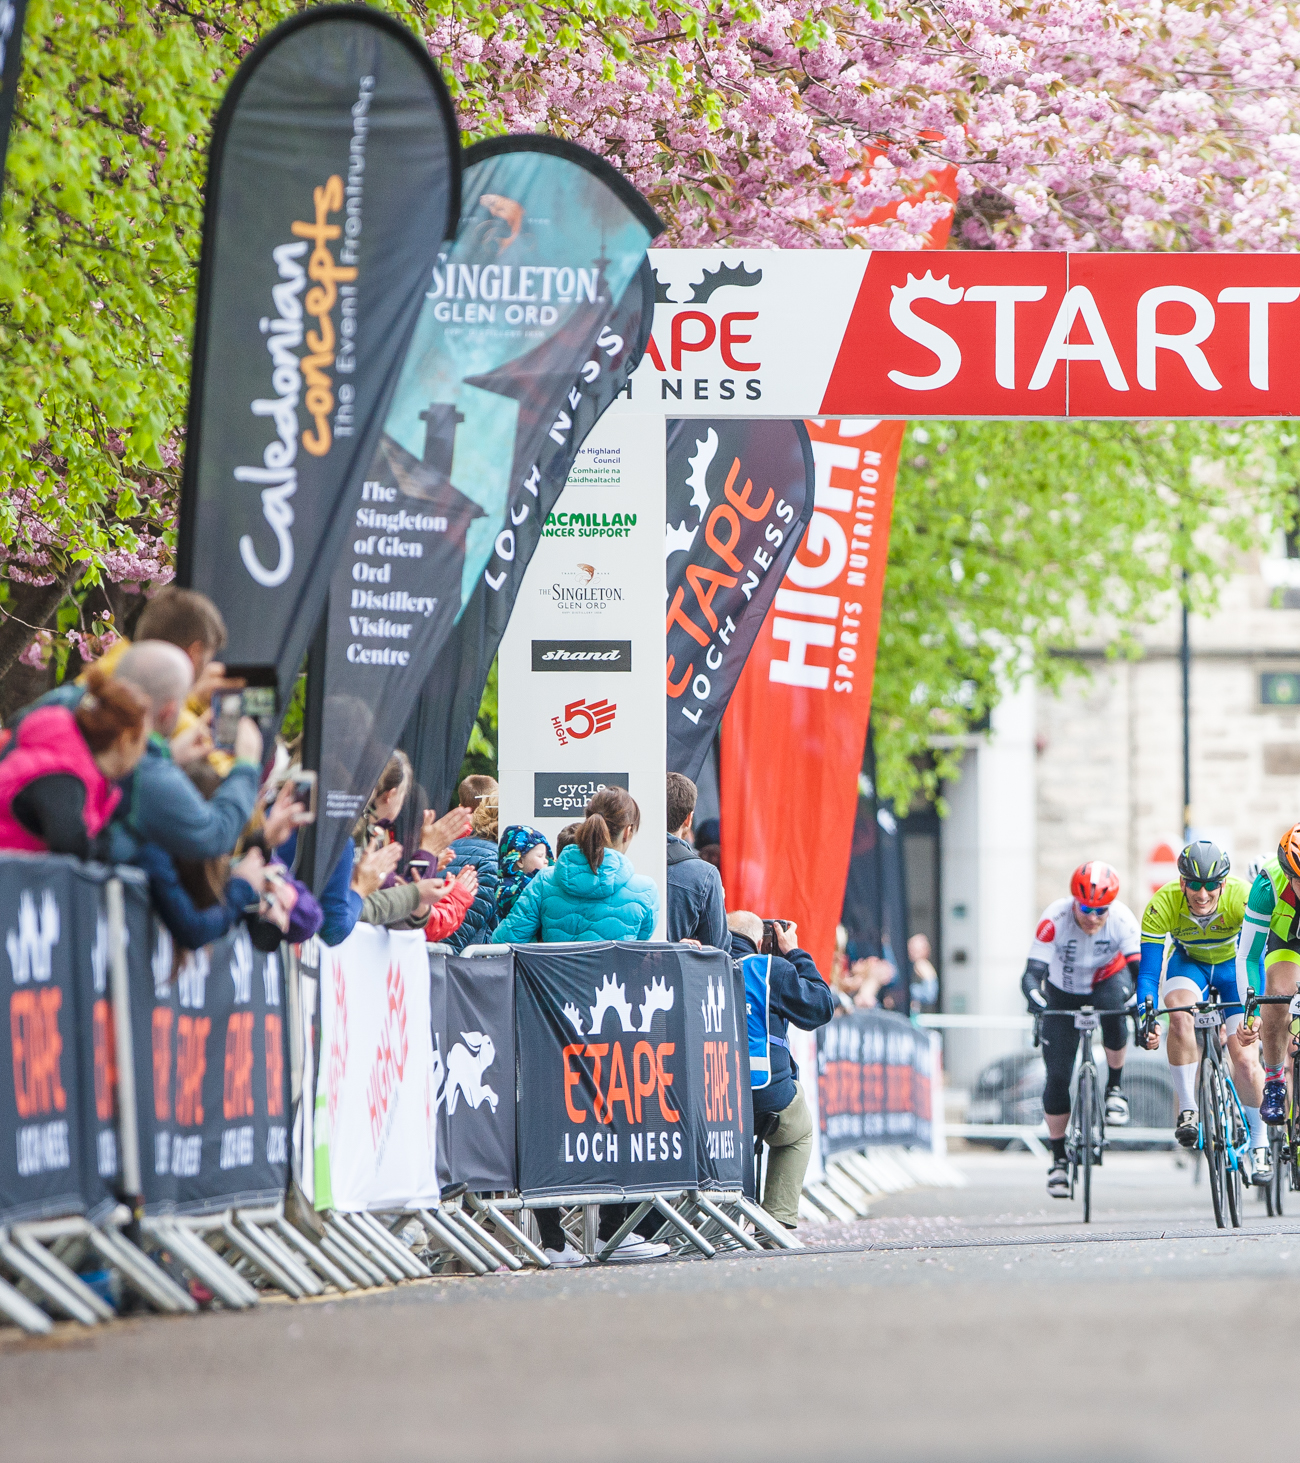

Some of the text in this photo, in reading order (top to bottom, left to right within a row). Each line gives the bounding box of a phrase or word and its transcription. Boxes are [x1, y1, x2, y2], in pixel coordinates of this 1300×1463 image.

[333, 75, 376, 440] The Event Frontrunners
[291, 174, 359, 457] concepts
[434, 301, 559, 326] GLEN ORD
[887, 268, 1300, 392] START
[661, 379, 763, 401] NESS
[234, 240, 308, 587] Caledonian
[587, 448, 621, 456] Highland
[572, 467, 610, 475] Comhairle
[361, 480, 397, 503] The
[356, 508, 449, 533] Singleton
[484, 464, 541, 592] LOCH
[545, 512, 637, 527] ACMILLAN
[846, 450, 883, 587] NUTRITION
[578, 528, 631, 538] SUPPORT
[354, 536, 423, 558] of Glen
[352, 562, 391, 584] Ord
[768, 440, 861, 690] HIGH
[350, 588, 438, 618] Distillery
[539, 588, 551, 596] THE
[557, 602, 607, 610] GLEN ORD
[682, 499, 795, 725] LOCH NESS
[348, 615, 412, 640] Visitor
[346, 643, 410, 667] Centre
[541, 649, 621, 661] shand
[833, 601, 863, 693] SPORTS
[550, 716, 569, 747] HIGH
[558, 781, 607, 796] cycle
[543, 795, 596, 811] repub
[1198, 1016, 1216, 1025] 671
[563, 1040, 680, 1125] ETAPE
[703, 1040, 733, 1122] ETAPE
[564, 1131, 683, 1163] LOCH NESS
